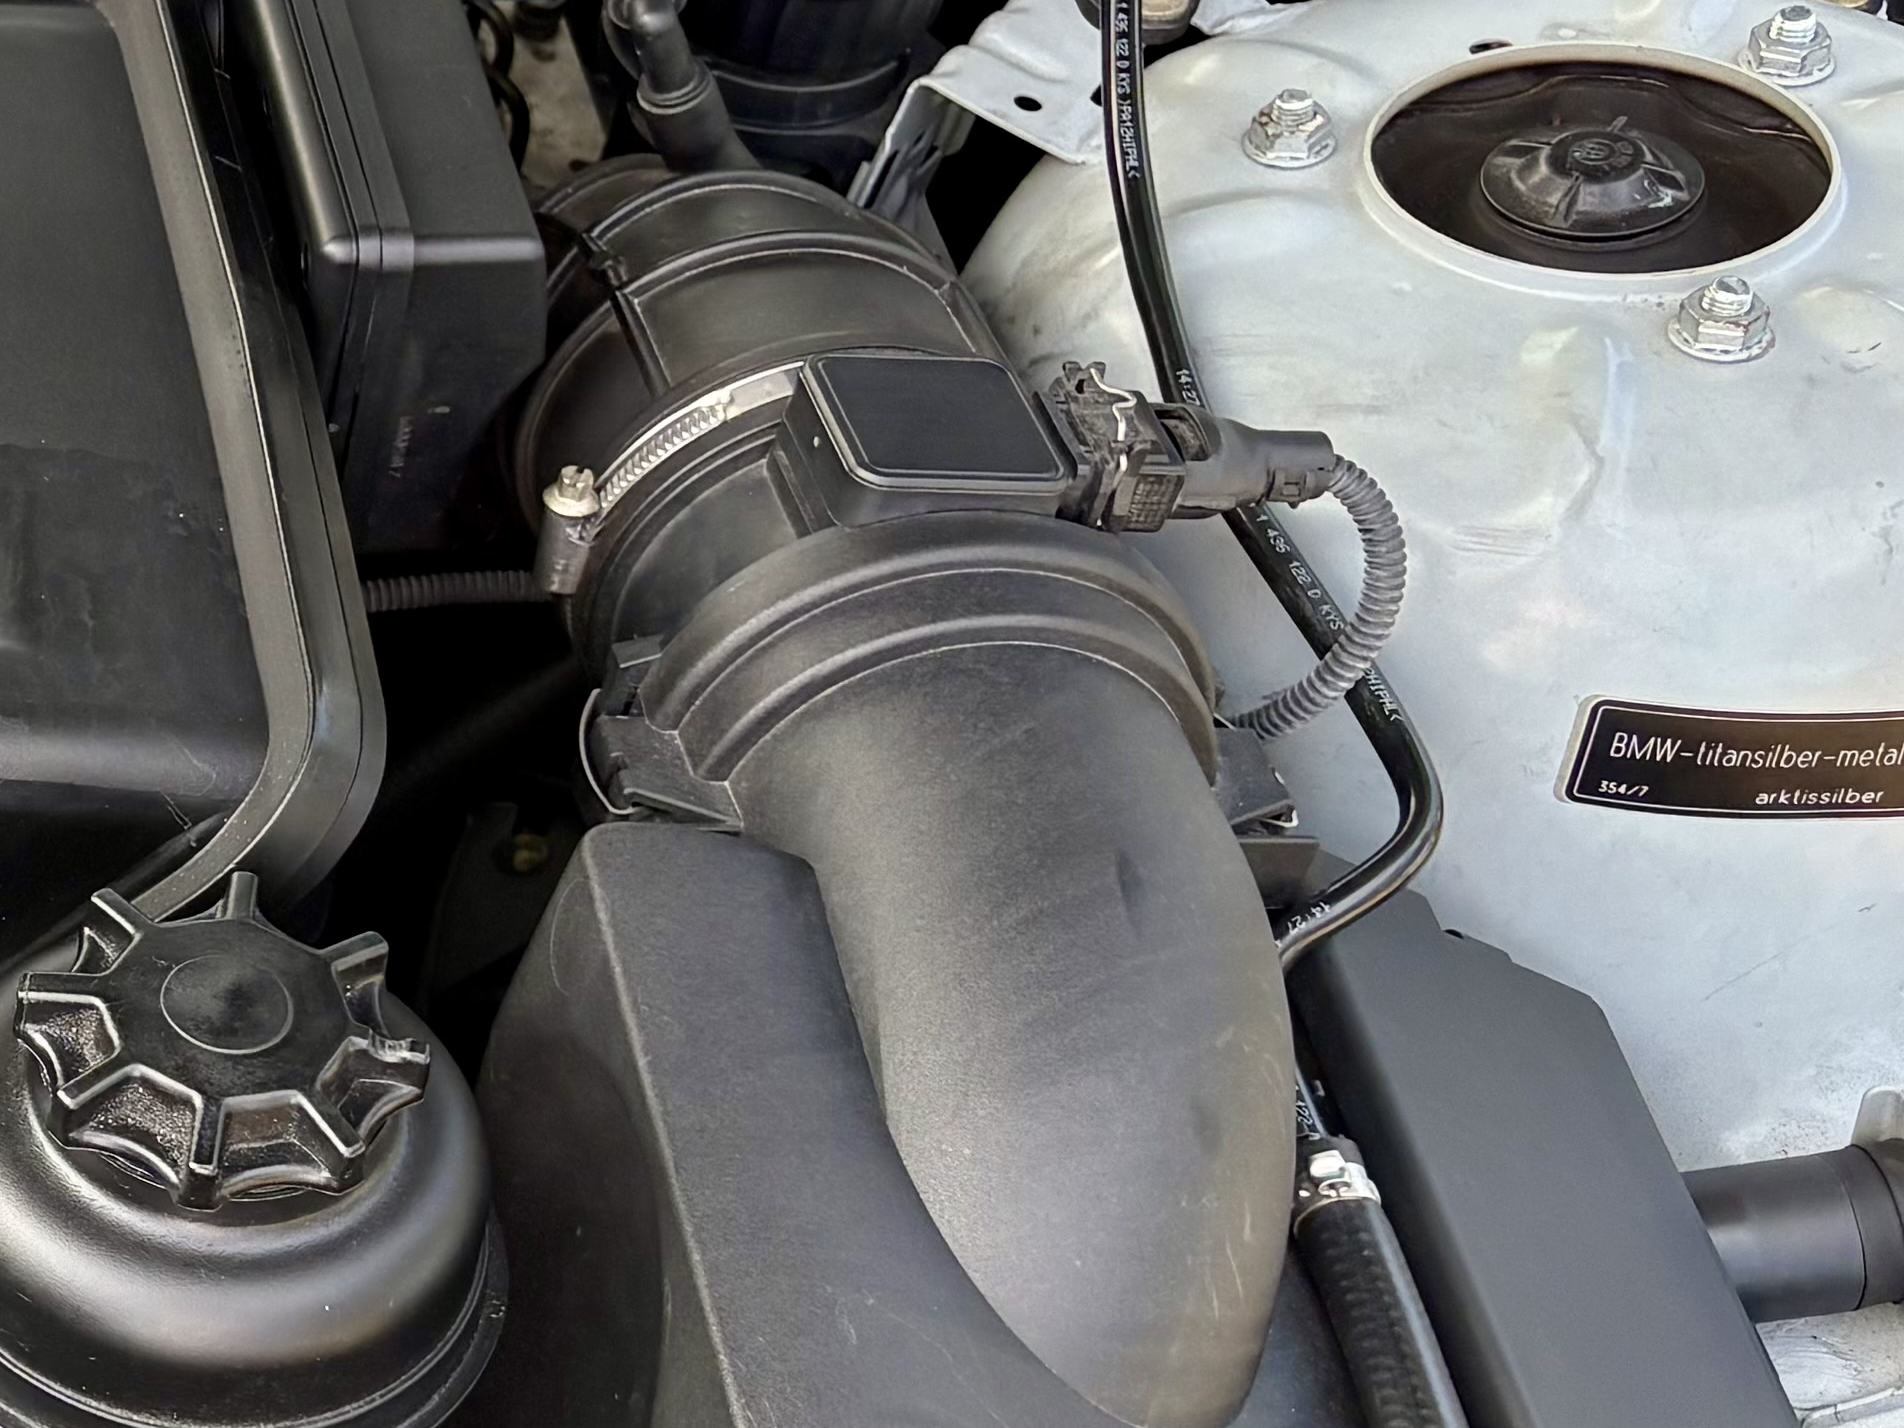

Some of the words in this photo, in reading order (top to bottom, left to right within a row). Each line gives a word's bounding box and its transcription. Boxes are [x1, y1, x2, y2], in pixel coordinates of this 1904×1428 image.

[1288, 560, 1312, 584] 122
[1318, 604, 1344, 631] KYS
[1598, 779, 1650, 798] 354/7
[1754, 788, 1885, 806] arktissilber
